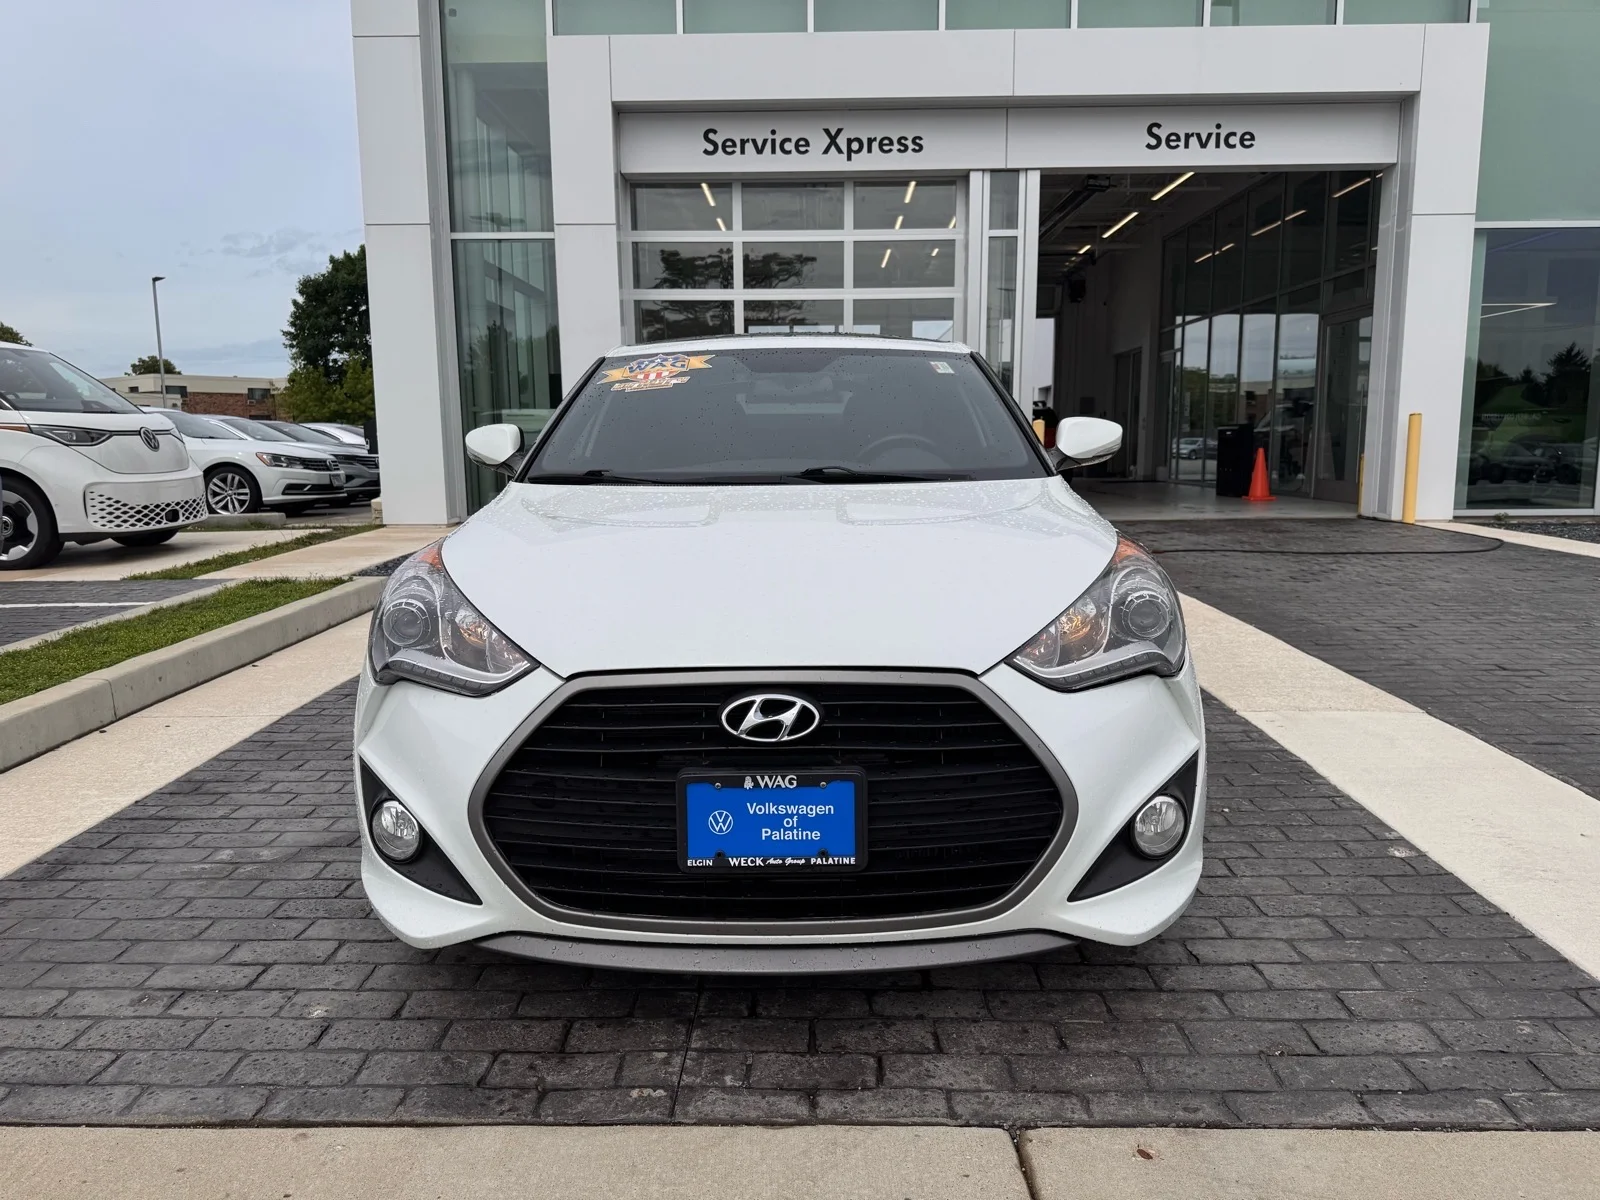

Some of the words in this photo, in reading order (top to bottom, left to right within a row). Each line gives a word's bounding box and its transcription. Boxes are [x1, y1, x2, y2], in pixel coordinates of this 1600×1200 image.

[1145, 122, 1256, 150] Service
[702, 128, 810, 156] Service
[821, 127, 924, 161] Xpress
[756, 775, 797, 788] WAG
[747, 803, 834, 817] Volkswagen
[783, 815, 798, 828] of
[762, 829, 821, 841] Palatine
[687, 859, 713, 867] ELGIN
[728, 857, 764, 867] WECK
[765, 857, 783, 865] Auto
[784, 857, 806, 866] Group
[810, 857, 856, 865] PALATINE
